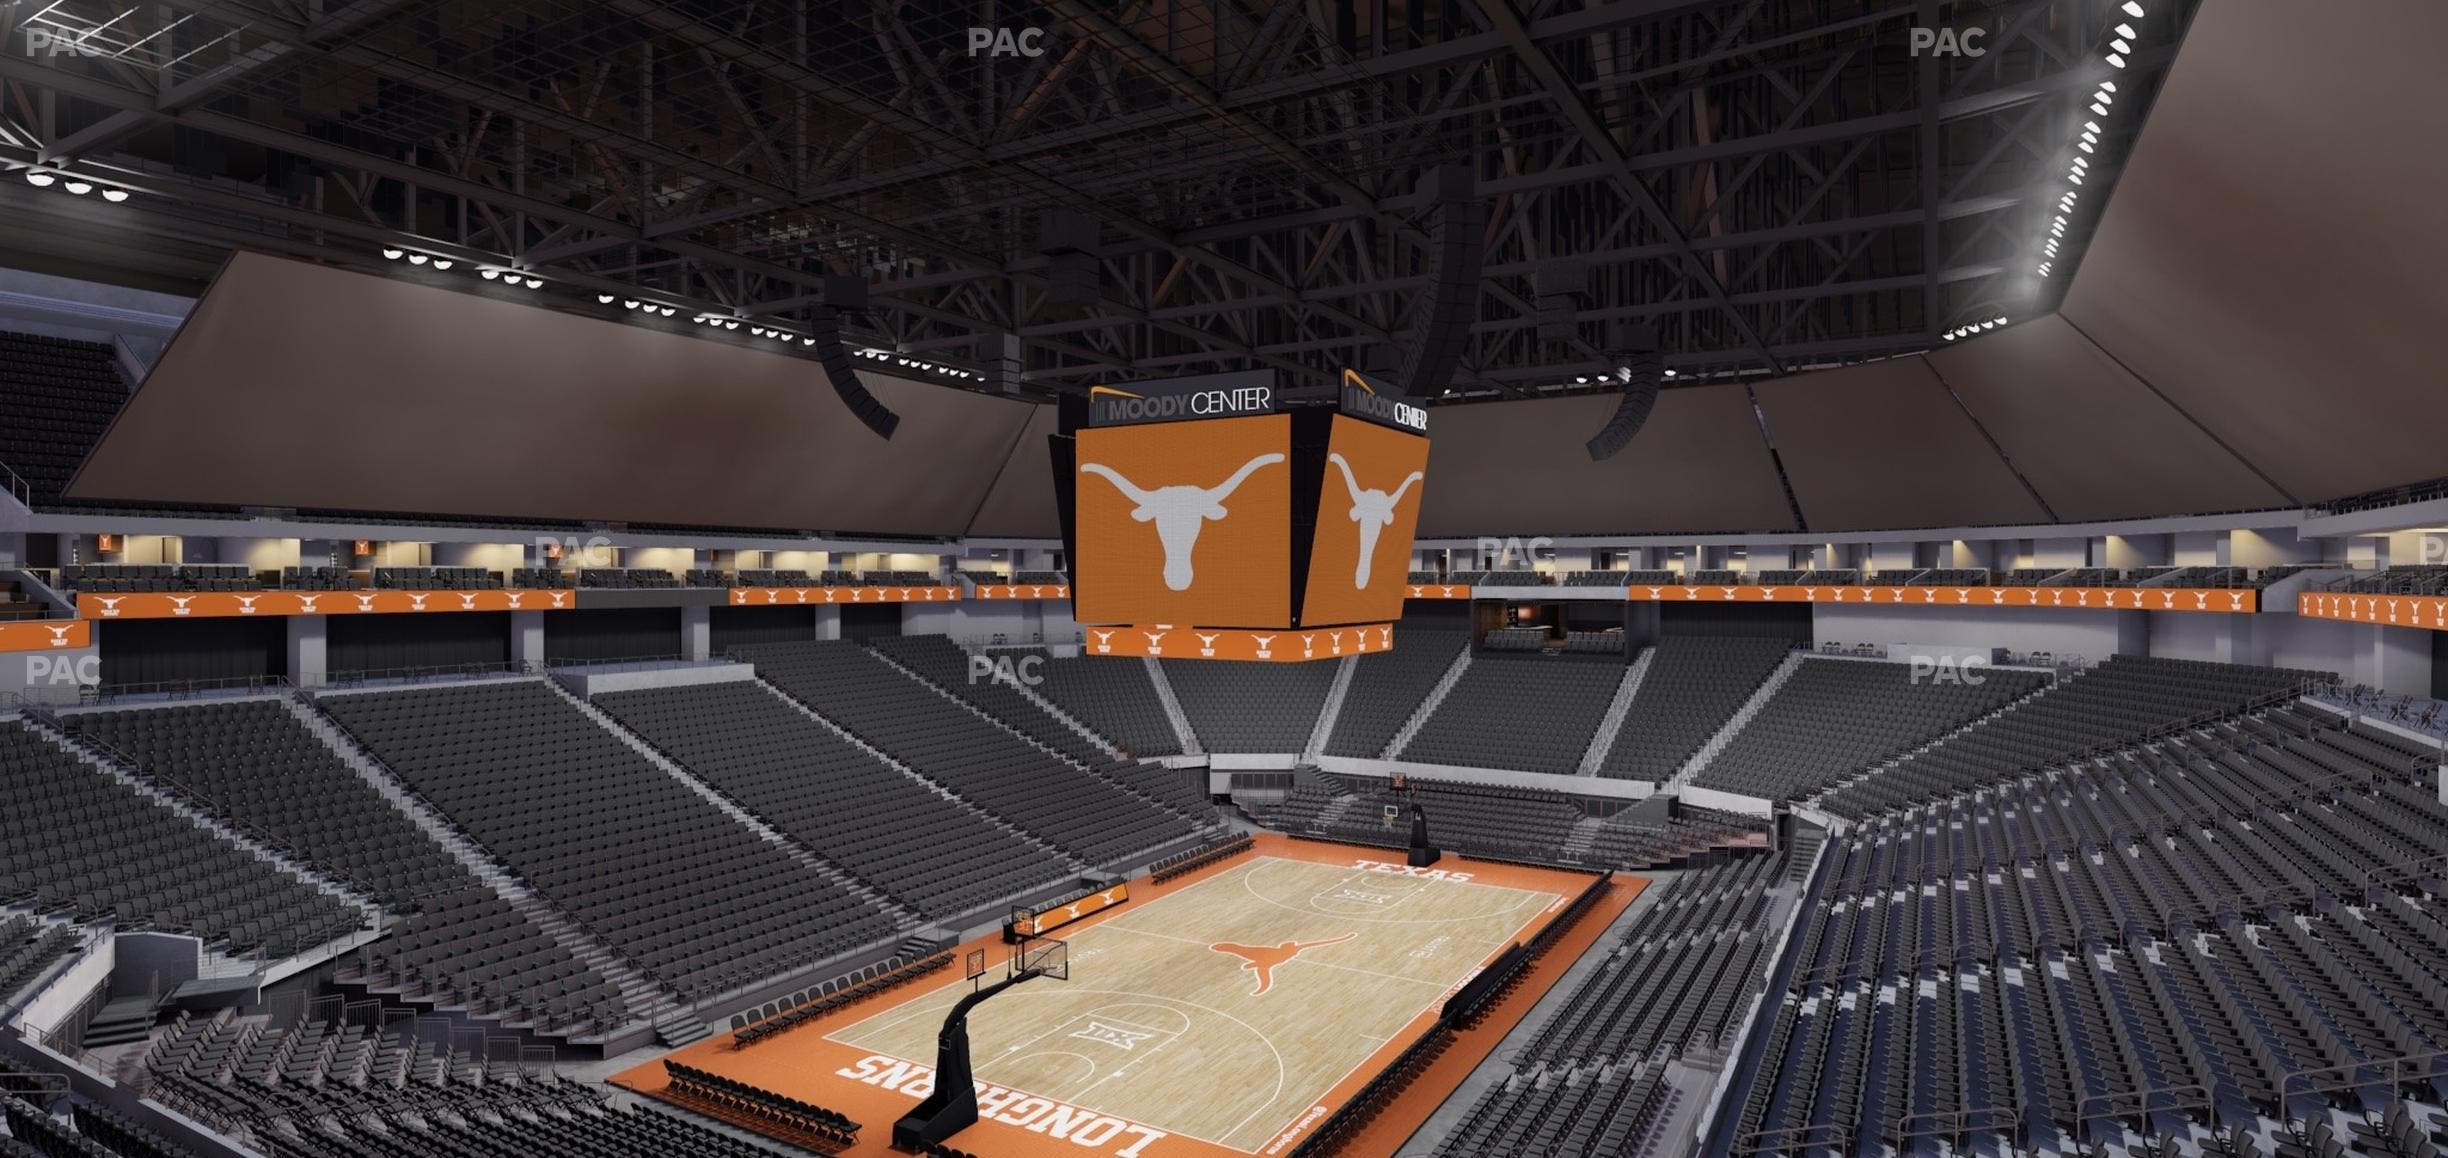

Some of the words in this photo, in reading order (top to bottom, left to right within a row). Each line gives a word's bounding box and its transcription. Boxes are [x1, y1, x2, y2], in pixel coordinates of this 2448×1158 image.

[1109, 394, 1190, 421] MOODY
[1191, 387, 1270, 415] CENTER
[1354, 394, 1396, 423] MOODY
[1395, 403, 1428, 431] CENTER
[1349, 860, 1475, 883] TEXAS
[835, 1054, 1167, 1158] LONGHRNS
